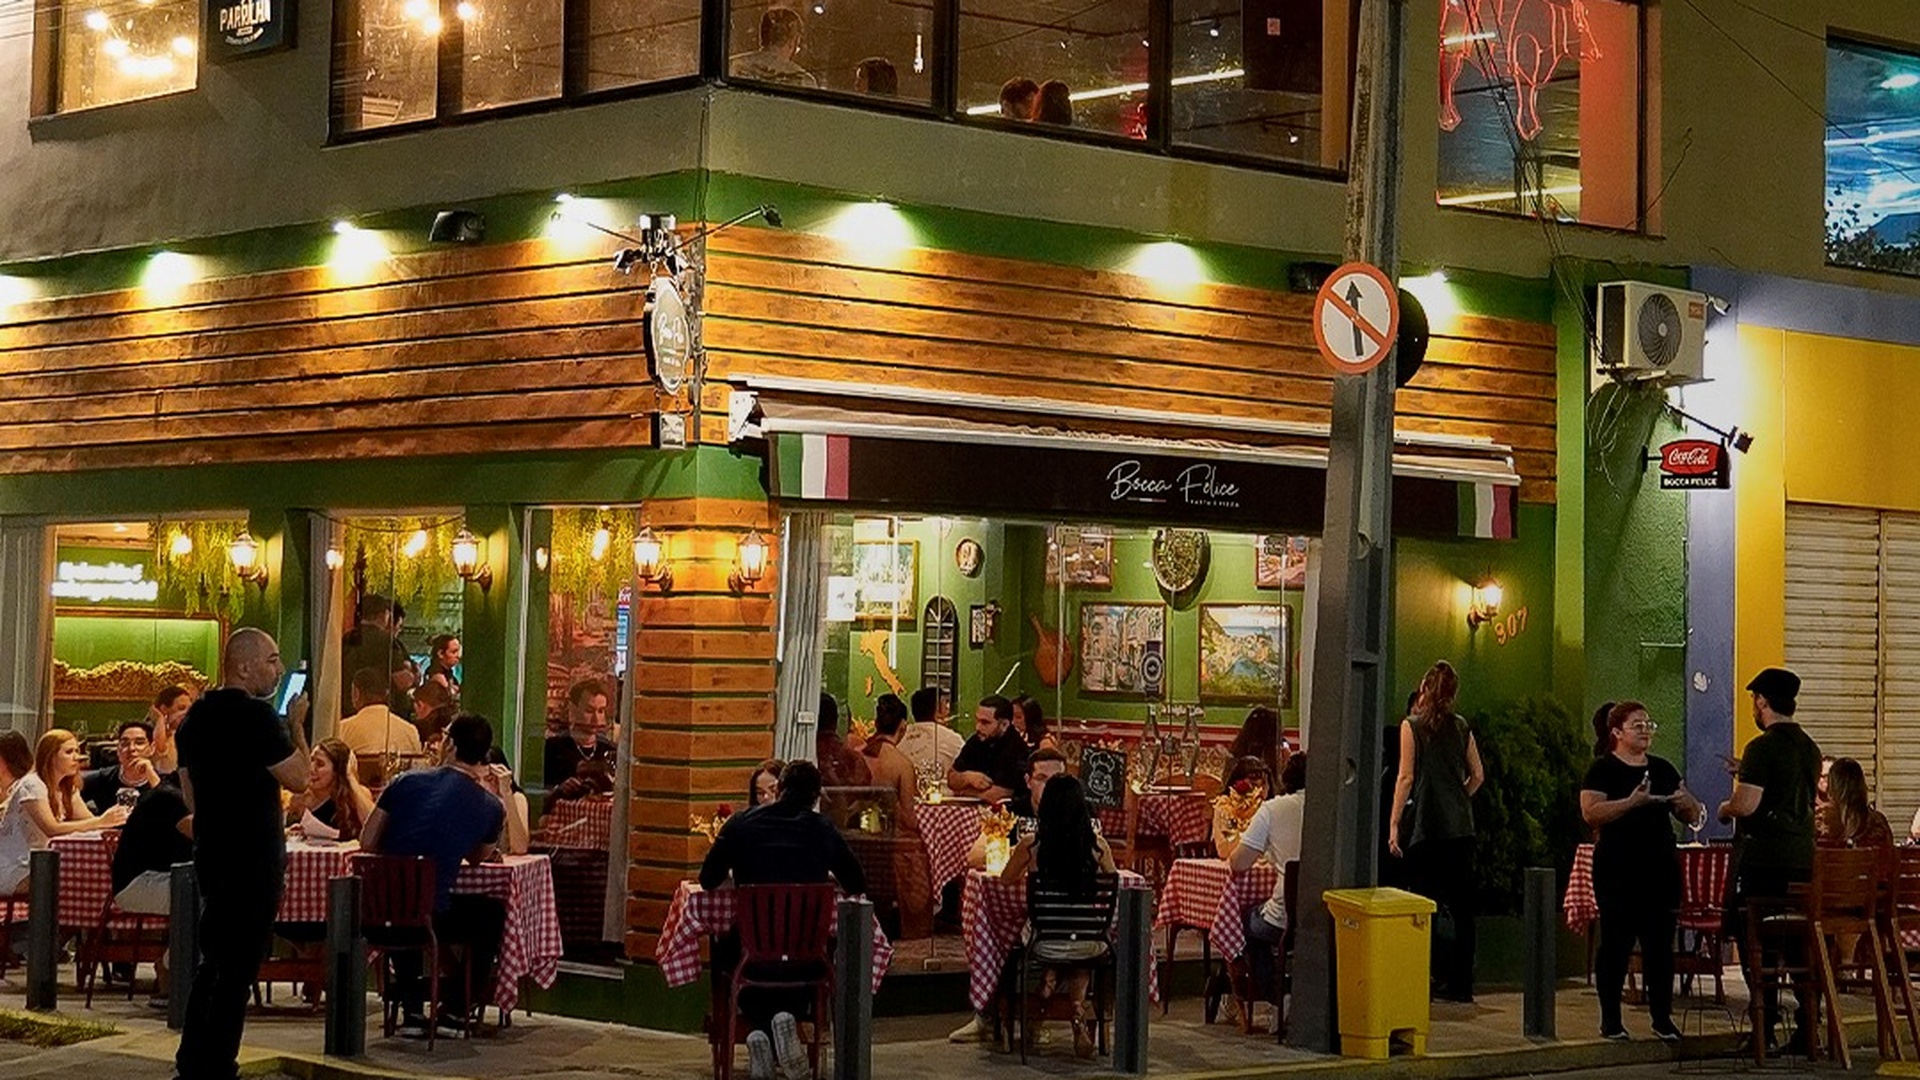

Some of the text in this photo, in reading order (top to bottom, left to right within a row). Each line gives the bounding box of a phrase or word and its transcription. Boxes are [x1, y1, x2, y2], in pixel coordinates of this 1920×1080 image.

[1106, 460, 1240, 503] Bocca Felice
[1663, 477, 1718, 487] BOCCA FELICE
[1495, 606, 1528, 646] 907
